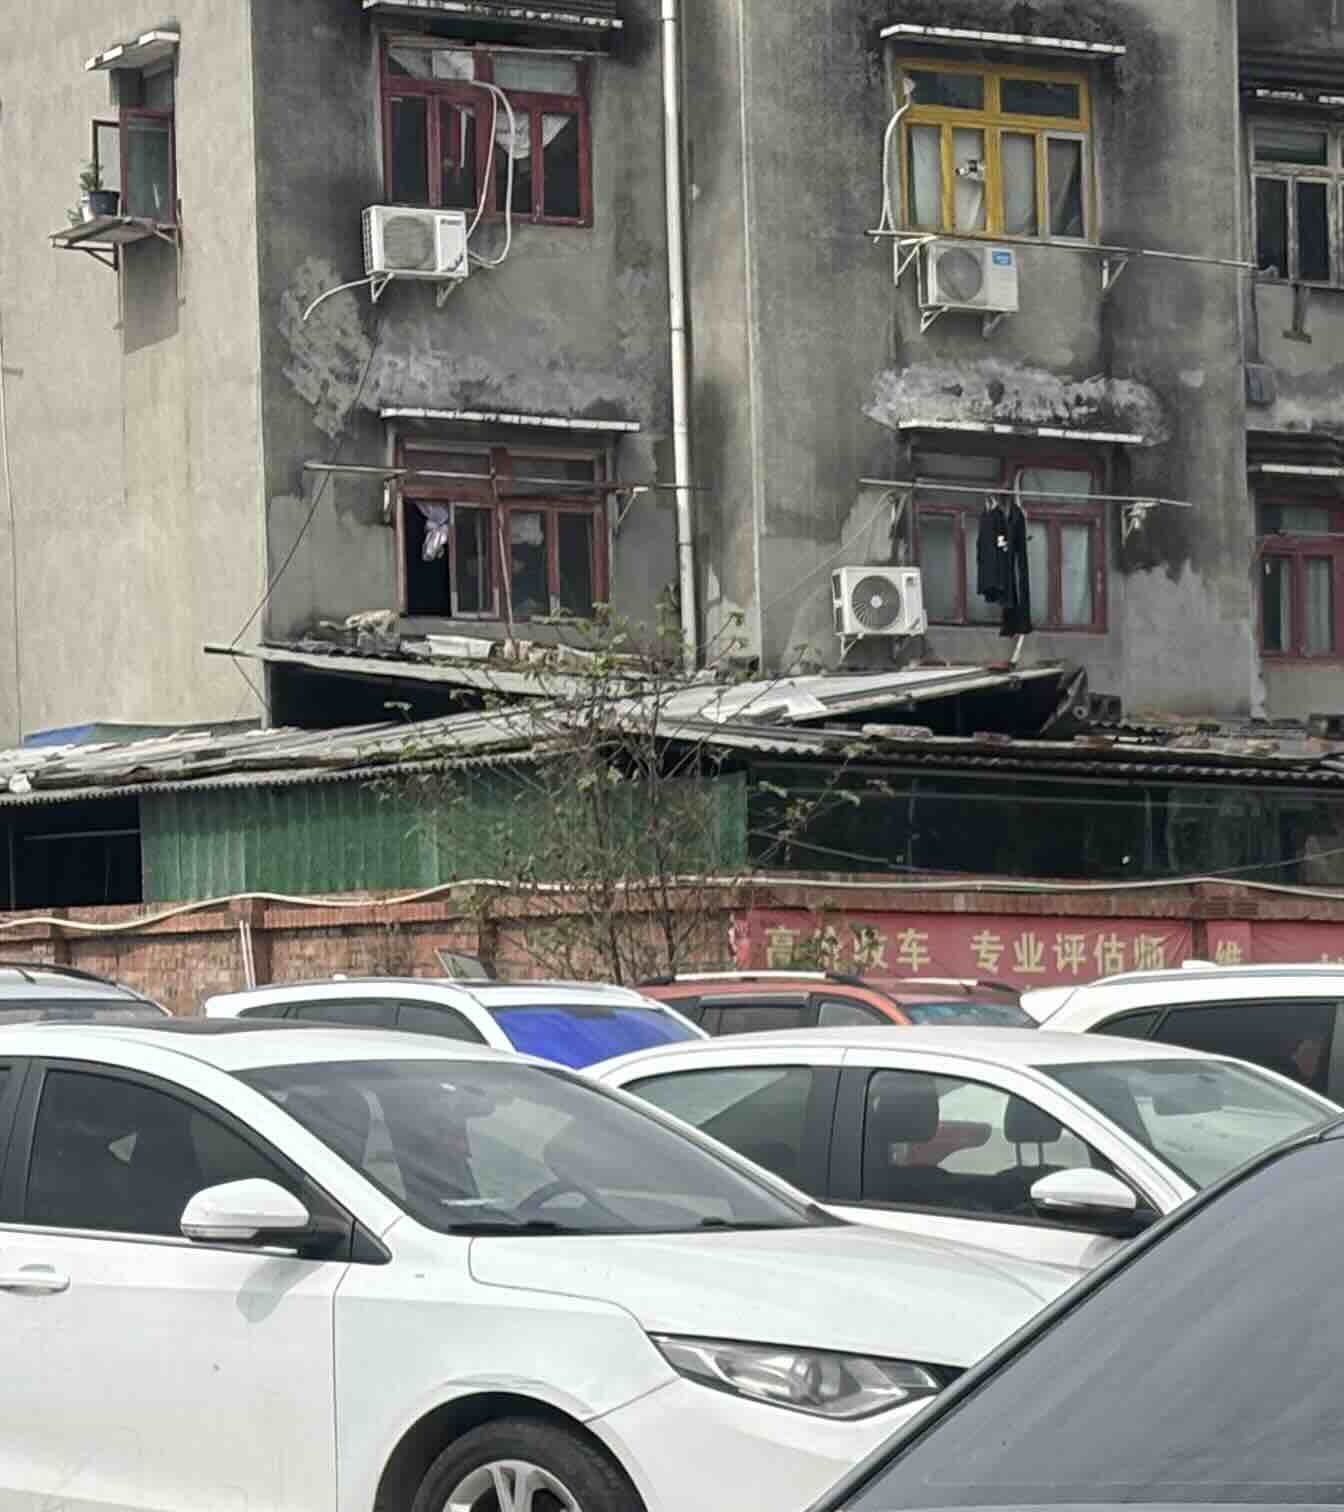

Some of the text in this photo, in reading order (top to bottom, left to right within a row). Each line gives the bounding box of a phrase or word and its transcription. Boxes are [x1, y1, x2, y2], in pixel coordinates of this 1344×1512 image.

[969, 930, 1168, 975] 专业评估师
